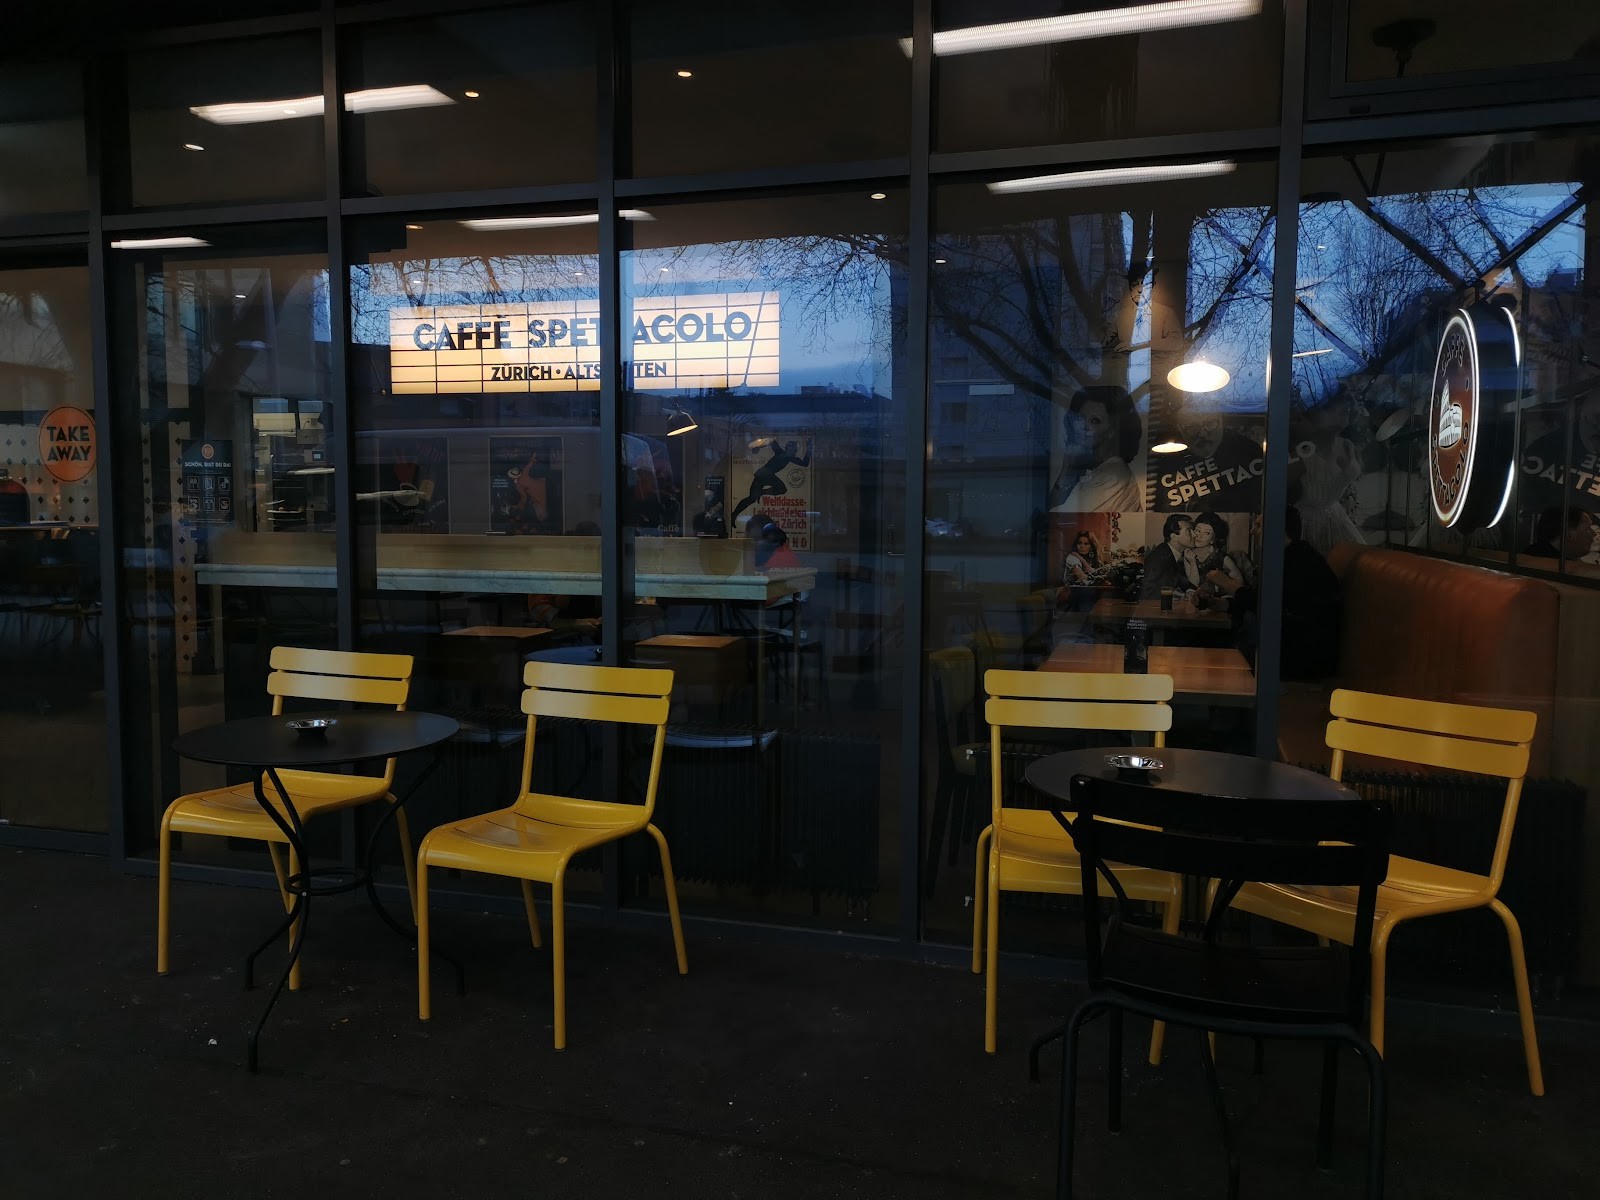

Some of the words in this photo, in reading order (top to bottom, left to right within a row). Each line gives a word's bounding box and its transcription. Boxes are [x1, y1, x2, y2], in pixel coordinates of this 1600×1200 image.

[413, 315, 512, 350] CAFFÈ
[528, 310, 752, 348] SPETACOLO
[491, 362, 552, 381] ZÜRICH
[563, 361, 667, 379] ALTSTEN
[46, 425, 90, 442] TAKE
[47, 445, 92, 462] AWAY
[1166, 440, 1317, 507] SPETTACLO
[781, 518, 807, 530] Zürich
